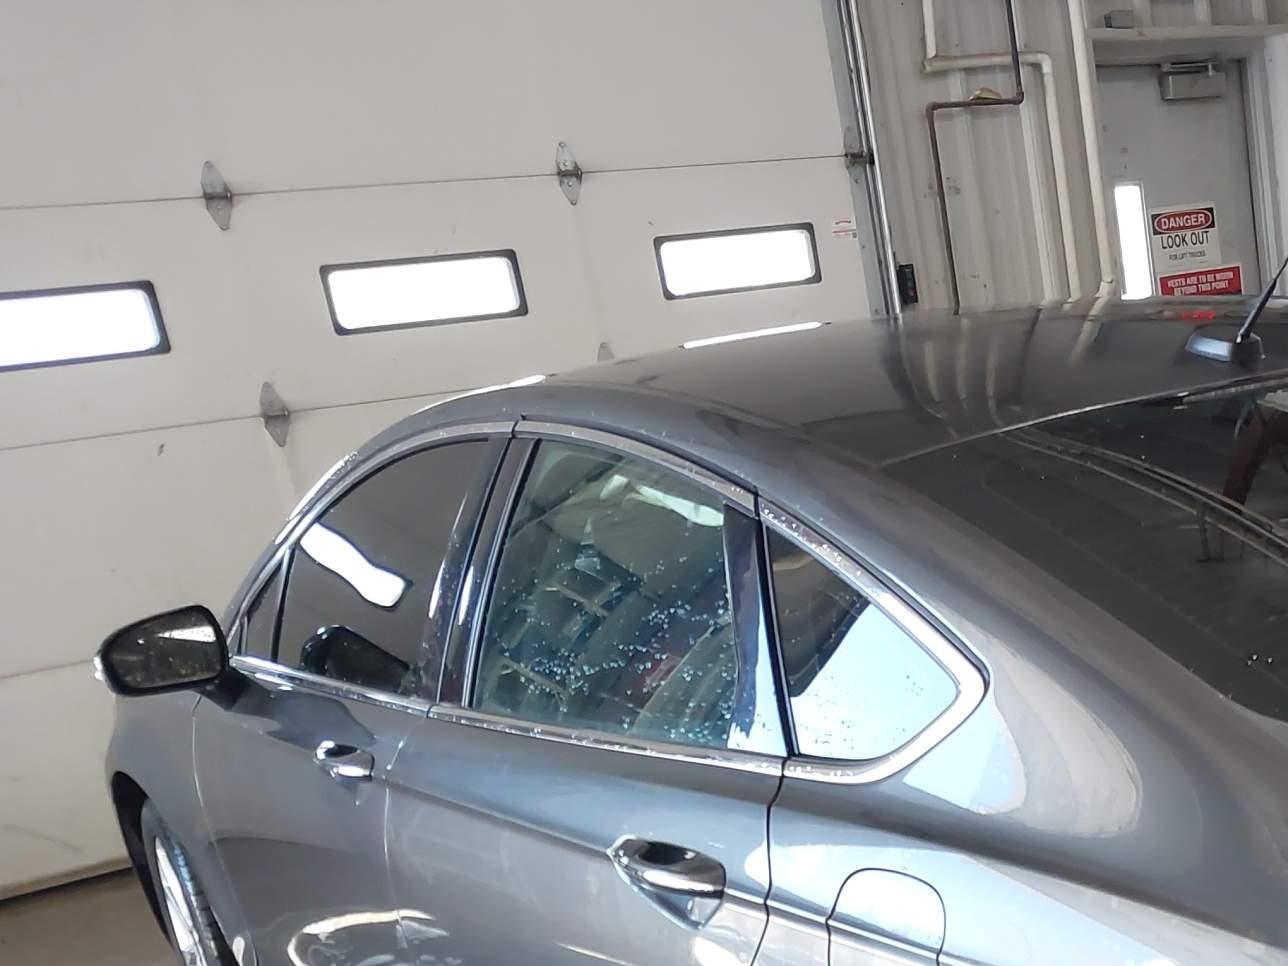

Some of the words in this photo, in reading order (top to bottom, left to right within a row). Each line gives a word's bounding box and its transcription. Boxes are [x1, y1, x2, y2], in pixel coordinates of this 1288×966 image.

[1161, 213, 1205, 229] DANGER
[1160, 233, 1189, 249] LOOK
[1190, 230, 1210, 245] OUT
